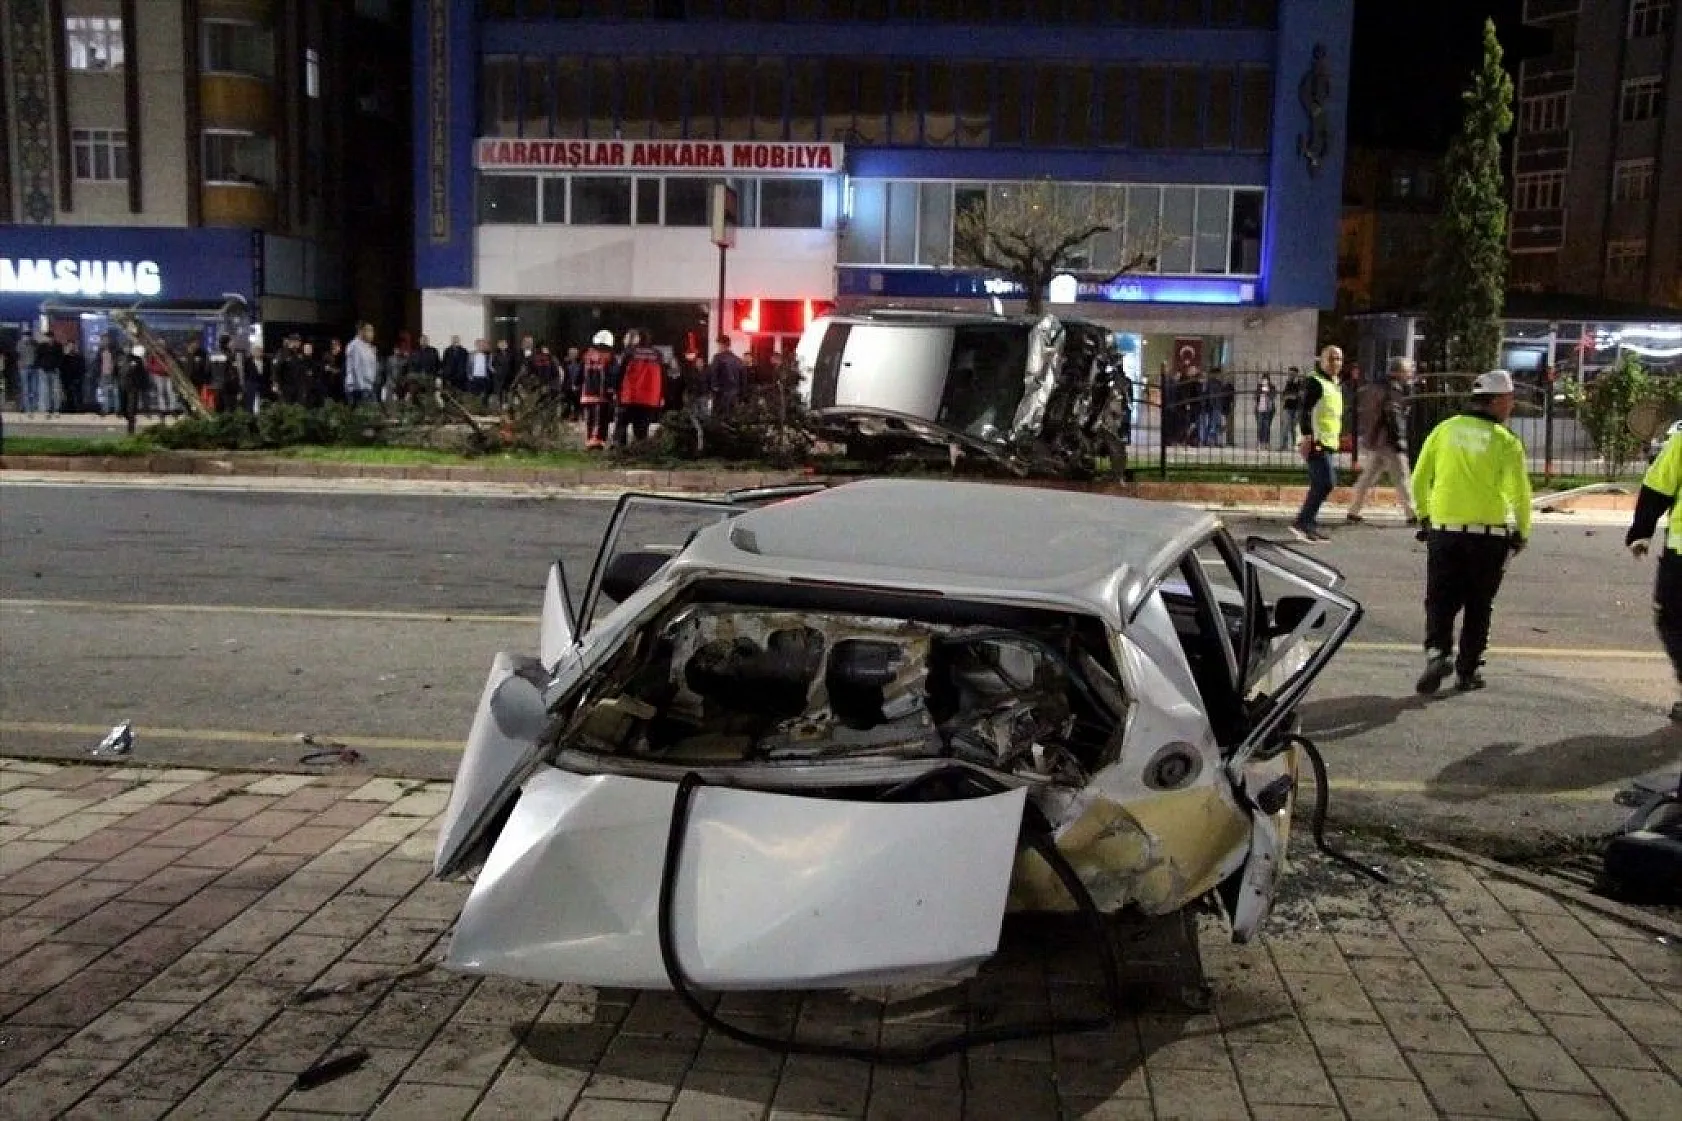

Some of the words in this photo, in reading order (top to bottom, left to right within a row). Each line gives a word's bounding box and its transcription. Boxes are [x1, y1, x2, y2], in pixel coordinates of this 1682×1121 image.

[480, 141, 624, 167] KARATAŞLAR
[631, 143, 725, 168] ANKARA
[0, 258, 161, 296] AMSUNG
